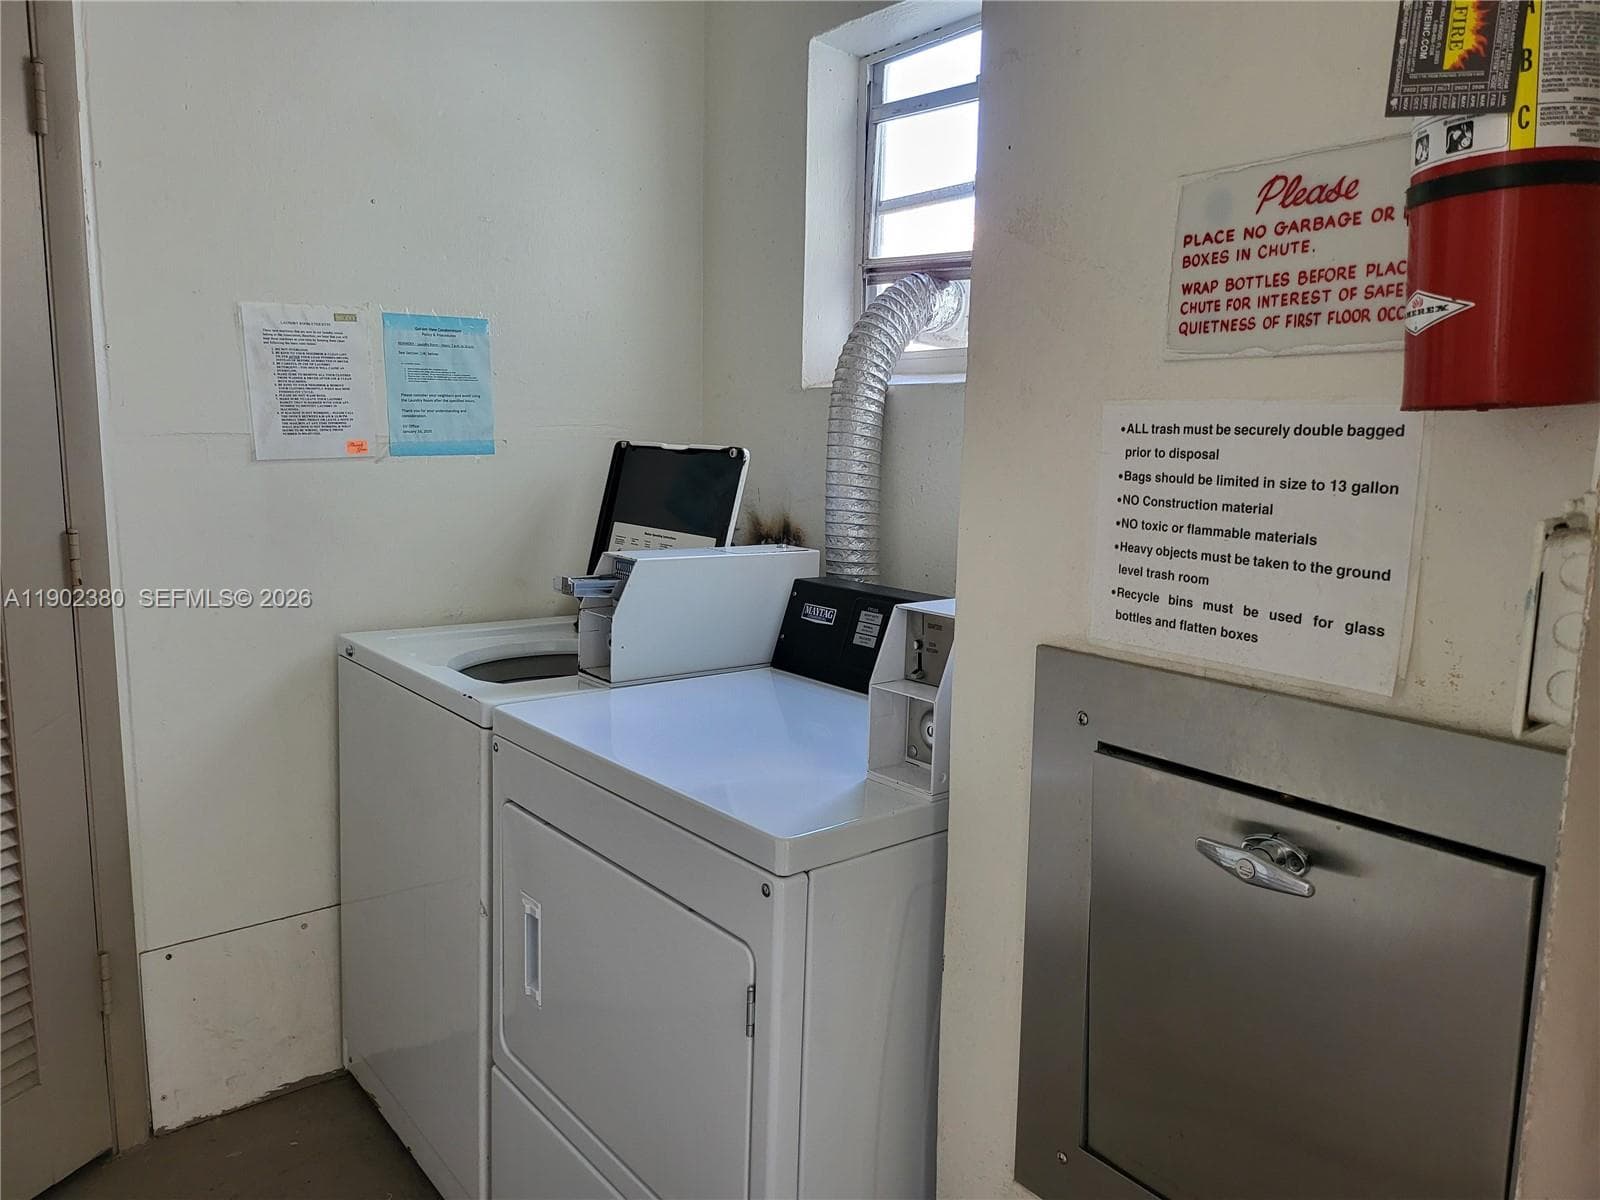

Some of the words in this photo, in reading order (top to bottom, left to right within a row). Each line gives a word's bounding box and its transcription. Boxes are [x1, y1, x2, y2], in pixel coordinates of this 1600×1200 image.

[1449, 7, 1468, 51] FIRE
[1520, 48, 1532, 72] B
[1518, 105, 1530, 130] C
[1256, 175, 1359, 214] Please
[1183, 229, 1234, 248] PLACE
[1244, 226, 1266, 240] NO
[1274, 211, 1362, 236] GARBAGE
[1371, 206, 1395, 223] OR
[1183, 250, 1230, 268] BOXES
[1236, 248, 1250, 261] IN
[1258, 240, 1315, 259] CHUTE.
[1182, 280, 1218, 296] WRAP
[1225, 272, 1290, 293] BOTTLES
[1298, 265, 1356, 286] BEFORE
[1180, 300, 1221, 315] CHUTE
[1226, 296, 1251, 311] FOR
[1257, 289, 1331, 309] INTEREST
[1338, 286, 1358, 301] OF
[1179, 316, 1256, 336] QUIETNESS
[1263, 314, 1279, 329] OF
[1285, 311, 1322, 328] FIRST
[1327, 307, 1371, 325] FLOOR
[1126, 423, 1149, 434] ALL
[1151, 424, 1180, 434] trash
[1183, 424, 1213, 435] must
[1216, 424, 1231, 435] be
[1234, 424, 1290, 439] securely
[1293, 424, 1343, 436] double
[1347, 424, 1405, 440] bagged
[1125, 447, 1151, 460] prior
[1155, 448, 1165, 458] to
[1169, 448, 1219, 462] disposal
[1122, 471, 1151, 485] Bags
[1155, 472, 1194, 484] should
[1198, 474, 1213, 485] be
[1217, 475, 1259, 488] limited
[1263, 476, 1275, 488] in
[1280, 477, 1307, 490] size
[1311, 479, 1325, 491] to
[1330, 480, 1347, 492] 13
[1352, 481, 1399, 496] gallon
[1123, 494, 1139, 505] NO
[1143, 496, 1217, 511] Construction
[1222, 502, 1273, 515] material
[1119, 518, 1138, 529] NO
[1141, 520, 1168, 532] toxic
[1172, 524, 1184, 533] or
[1187, 523, 1251, 540] flammable
[1255, 531, 1317, 545] materials
[1118, 541, 1153, 557] Heavy
[1156, 546, 1198, 560] objects
[1201, 552, 1232, 564] must
[1235, 553, 1250, 565] be
[1253, 556, 1289, 570] taken
[1293, 560, 1306, 572] to
[1310, 562, 1333, 575] the
[1336, 567, 1391, 581] ground
[1119, 564, 1143, 576] level
[1147, 568, 1174, 581] trash
[1179, 574, 1209, 585] room
[804, 604, 834, 620] MAYTAG
[1115, 587, 1159, 603] Recycle
[1168, 594, 1193, 608] bins
[1203, 602, 1233, 614] must
[1243, 605, 1259, 617] be
[1269, 611, 1302, 624] used
[1313, 615, 1334, 629] for
[1345, 621, 1384, 637] glass
[1116, 609, 1152, 625] bottles
[1155, 618, 1176, 629] and
[1180, 619, 1216, 636] flatten
[1221, 626, 1258, 643] boxes
